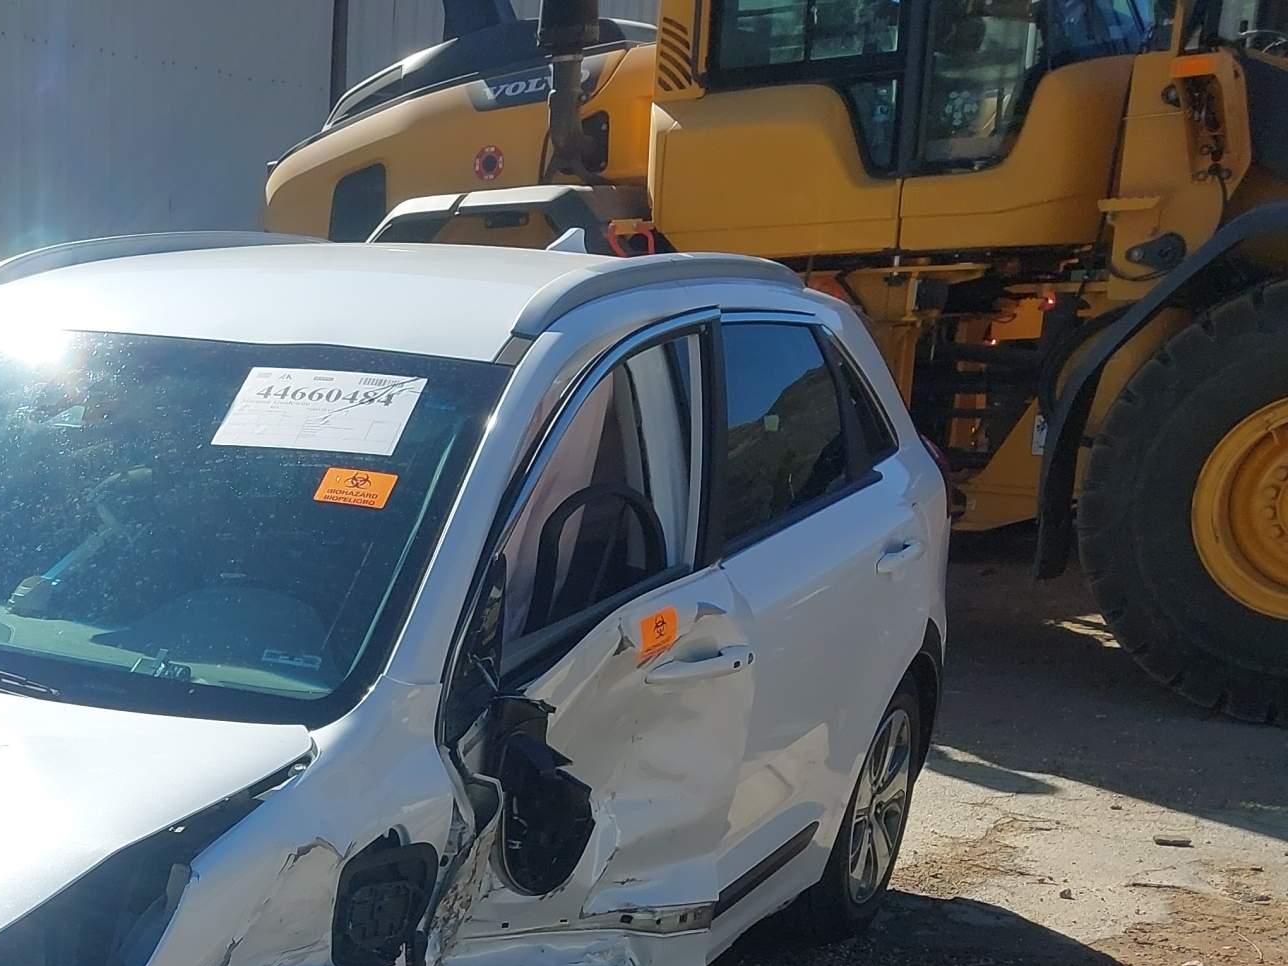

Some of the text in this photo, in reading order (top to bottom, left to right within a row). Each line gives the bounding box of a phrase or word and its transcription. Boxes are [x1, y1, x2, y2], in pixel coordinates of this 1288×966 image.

[256, 384, 395, 407] 44660484
[322, 494, 376, 506] BIOPELIGRO
[326, 488, 379, 500] BIOHAZARD
